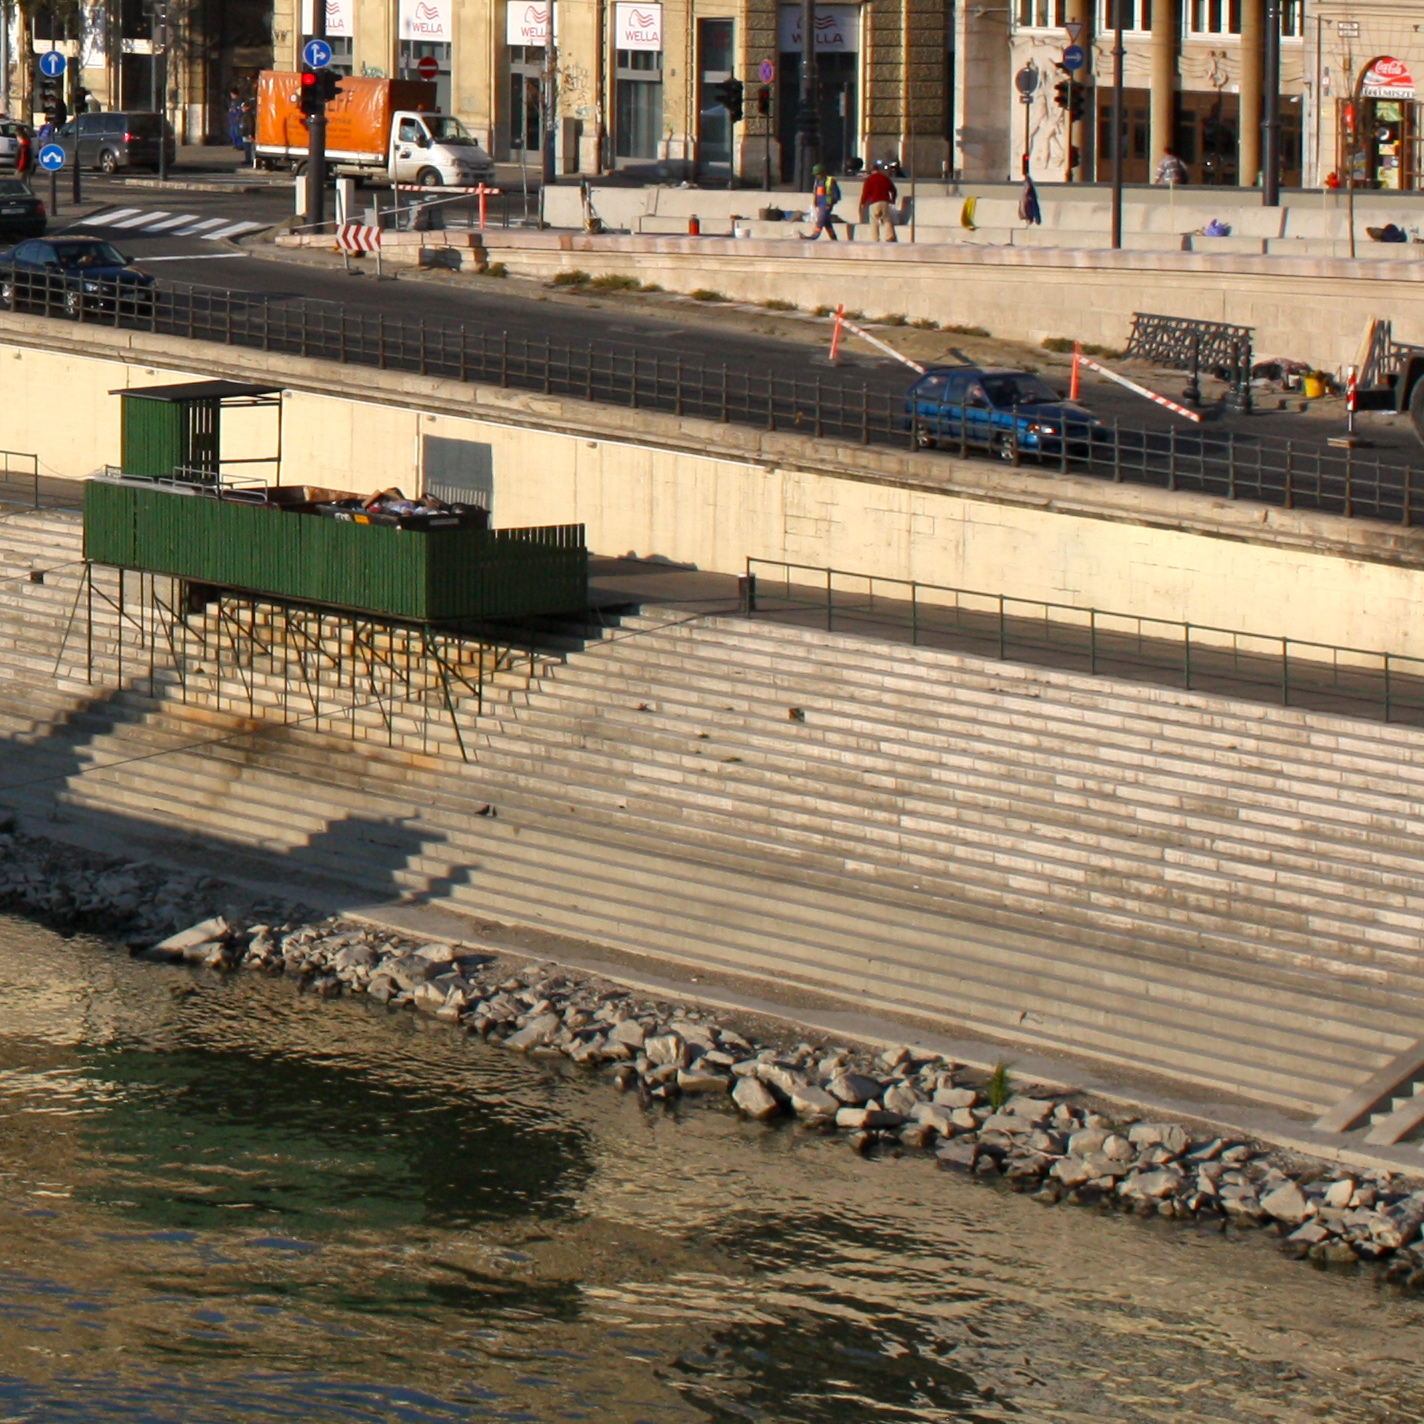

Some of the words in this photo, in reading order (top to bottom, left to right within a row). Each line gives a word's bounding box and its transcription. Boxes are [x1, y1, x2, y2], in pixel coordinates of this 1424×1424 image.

[412, 22, 444, 34] WELLA
[624, 30, 660, 42] WELLA
[791, 32, 844, 44] WLLA
